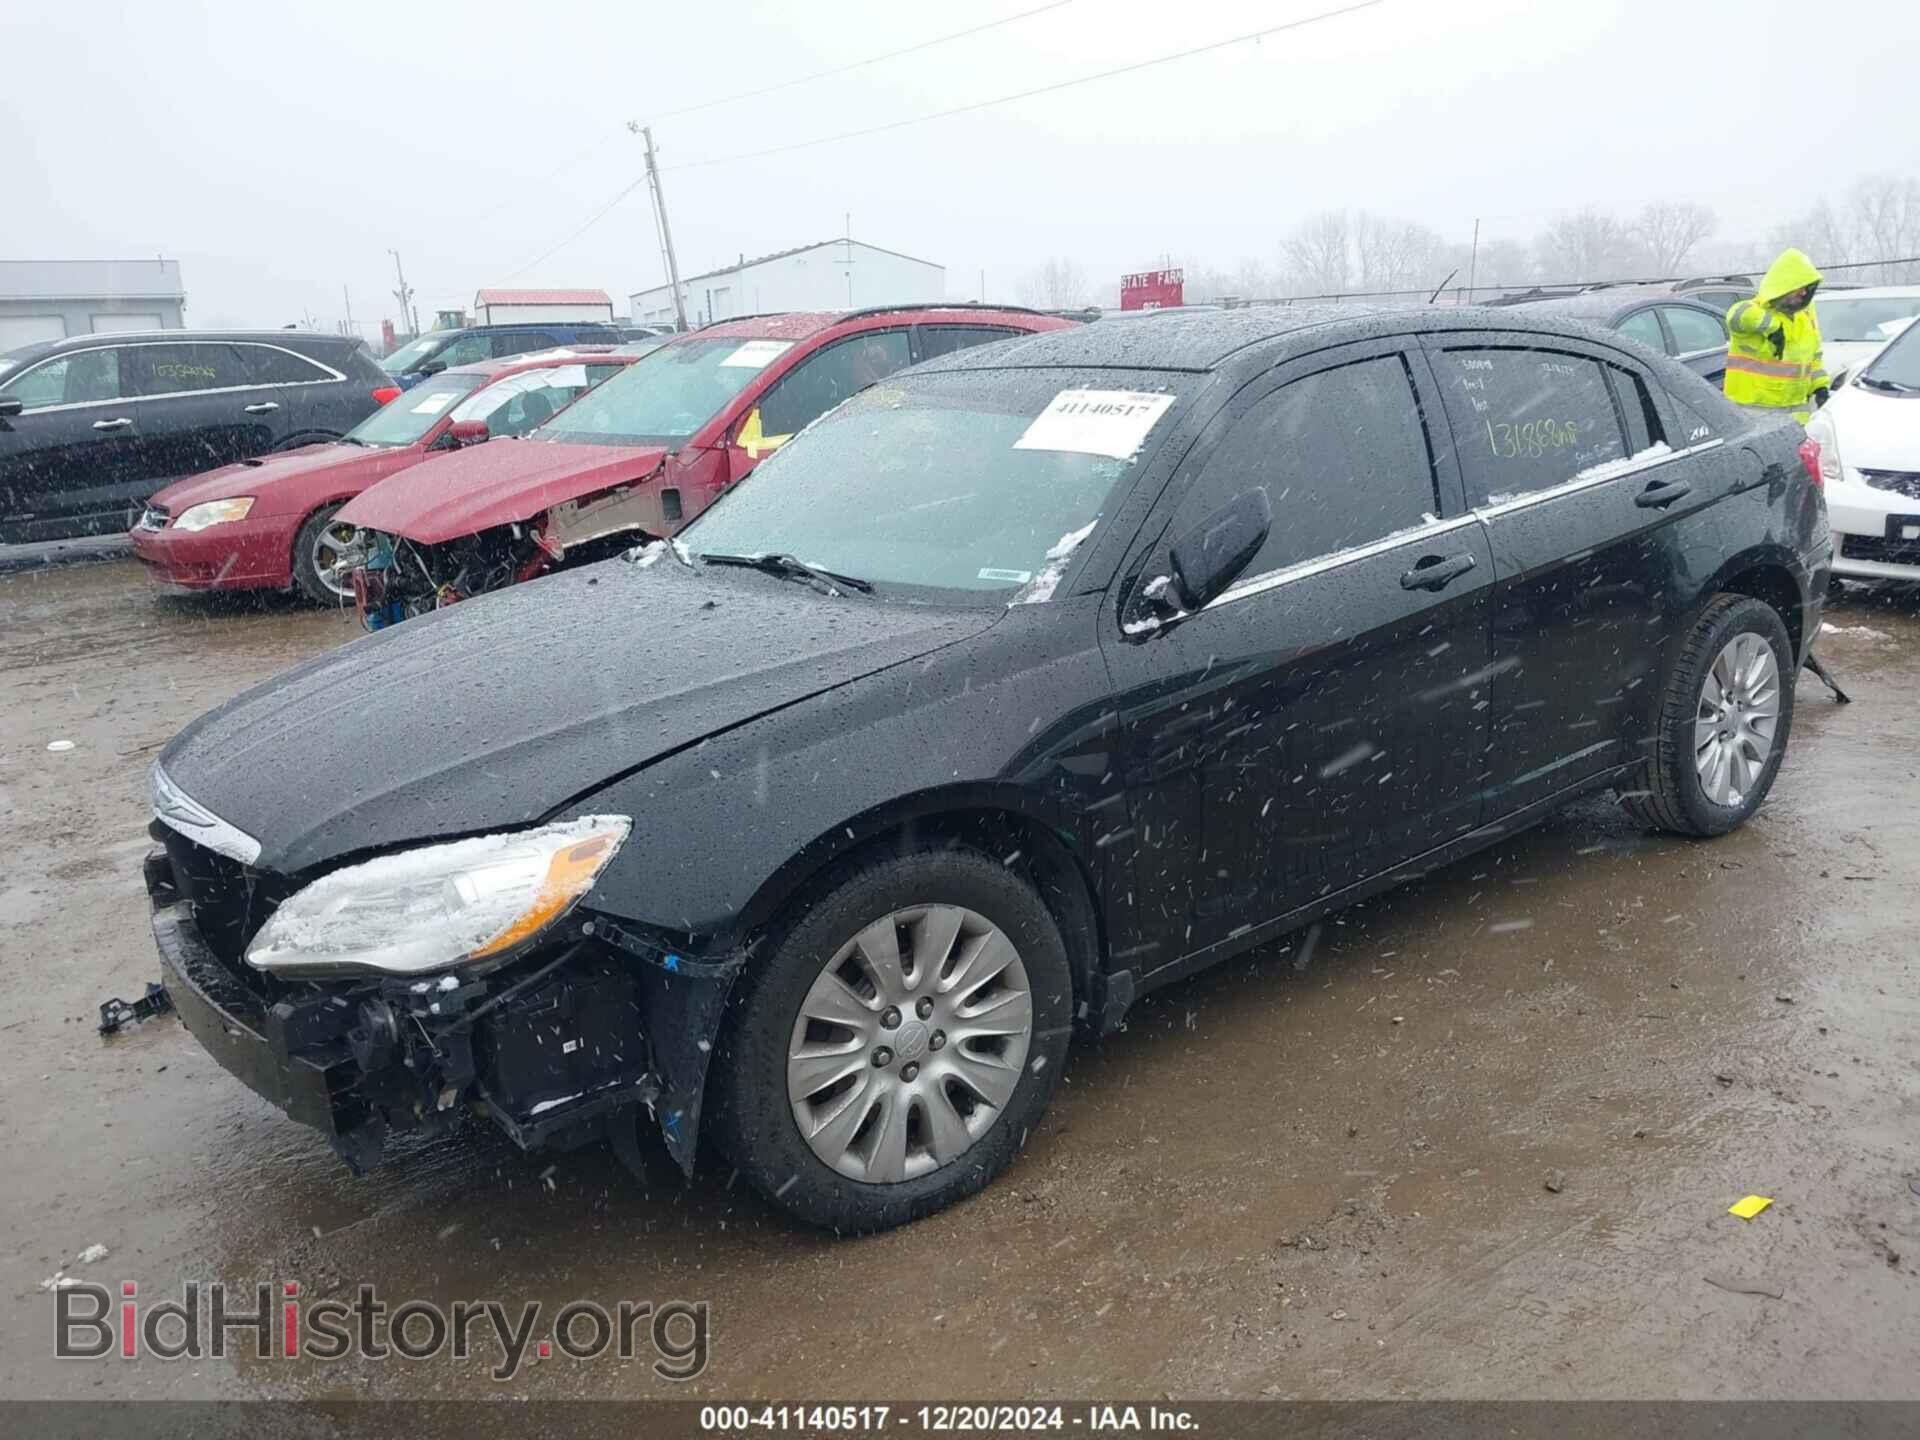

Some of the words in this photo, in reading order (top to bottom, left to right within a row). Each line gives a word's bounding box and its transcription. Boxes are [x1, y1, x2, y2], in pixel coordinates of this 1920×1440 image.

[1121, 274, 1149, 289] STATE
[1157, 271, 1183, 287] FARM
[1056, 402, 1151, 417] 41140517
